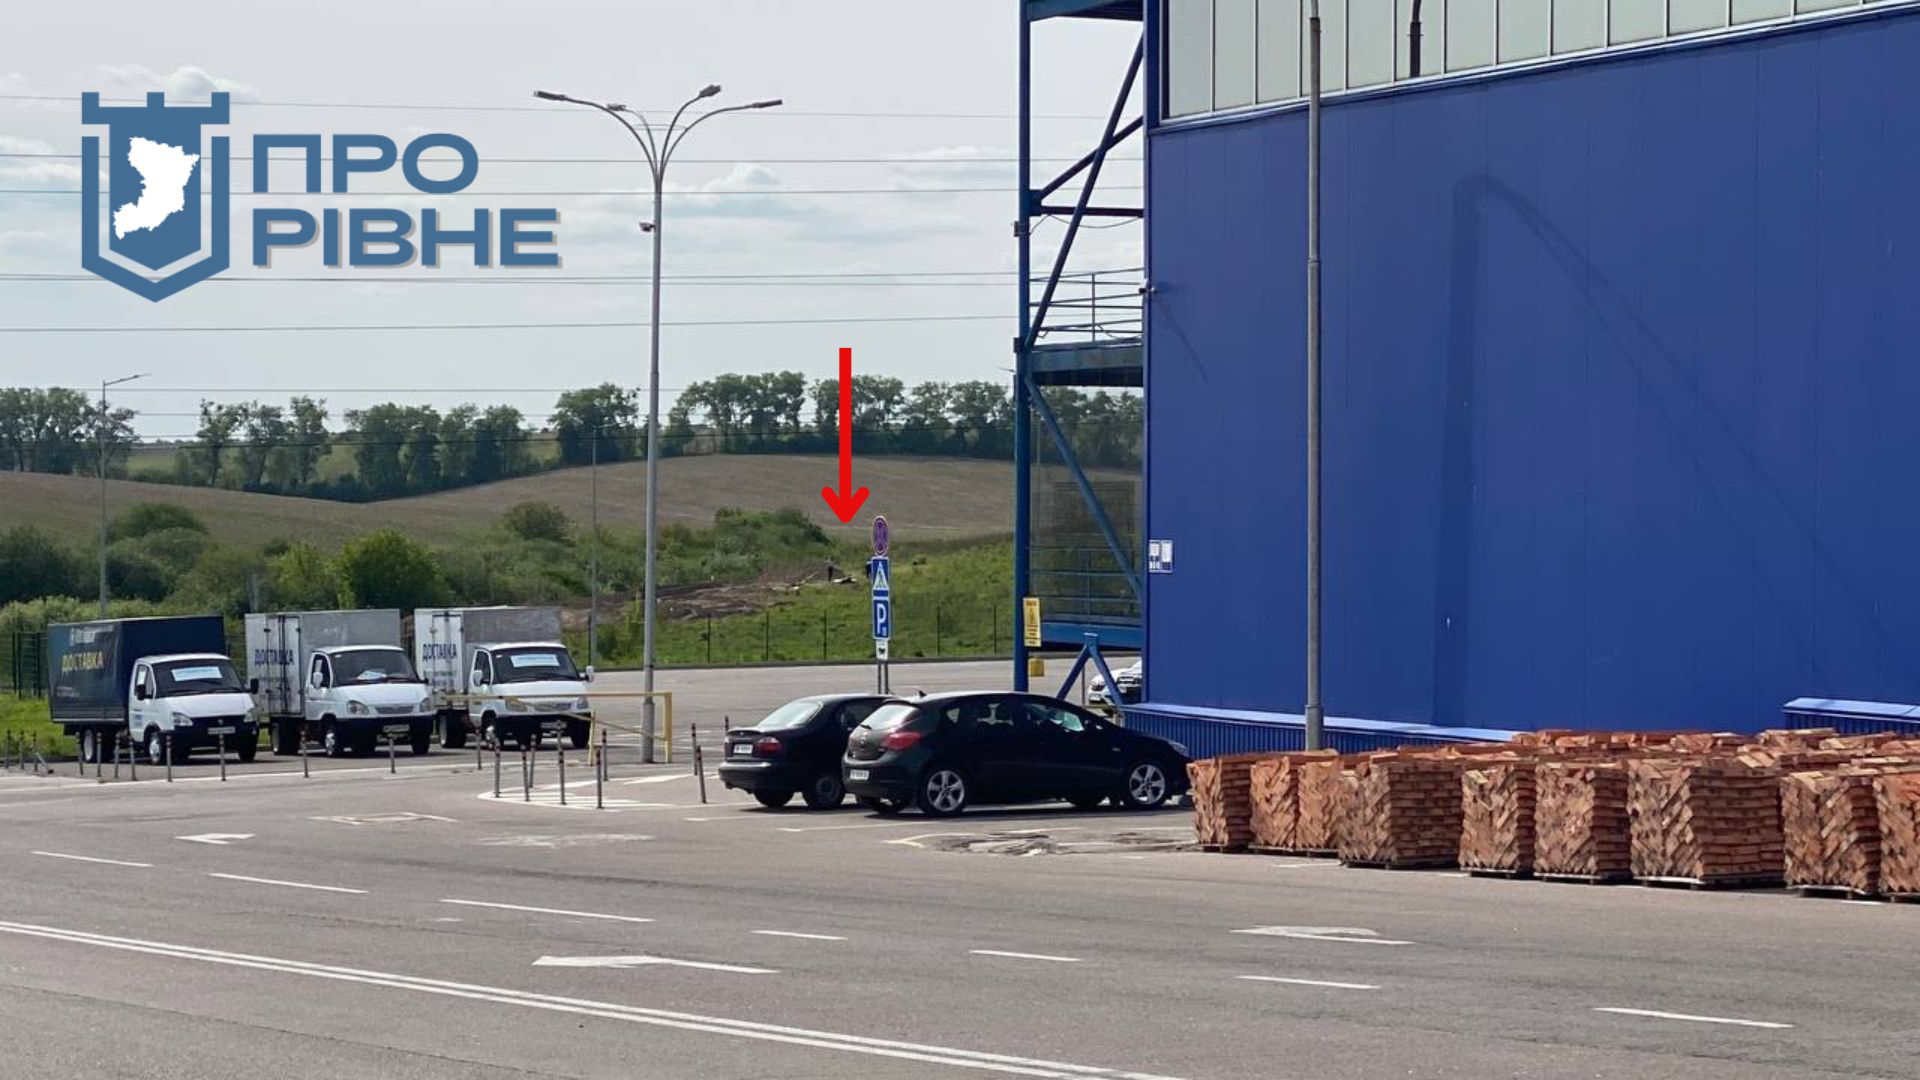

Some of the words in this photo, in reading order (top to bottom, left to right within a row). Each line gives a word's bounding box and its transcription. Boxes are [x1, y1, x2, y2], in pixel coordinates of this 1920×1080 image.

[877, 602, 887, 635] P
[62, 651, 104, 672] ДОСТАВКА
[255, 649, 294, 667] ДОСТАВКА
[422, 643, 457, 661] ДОСТАВКА
